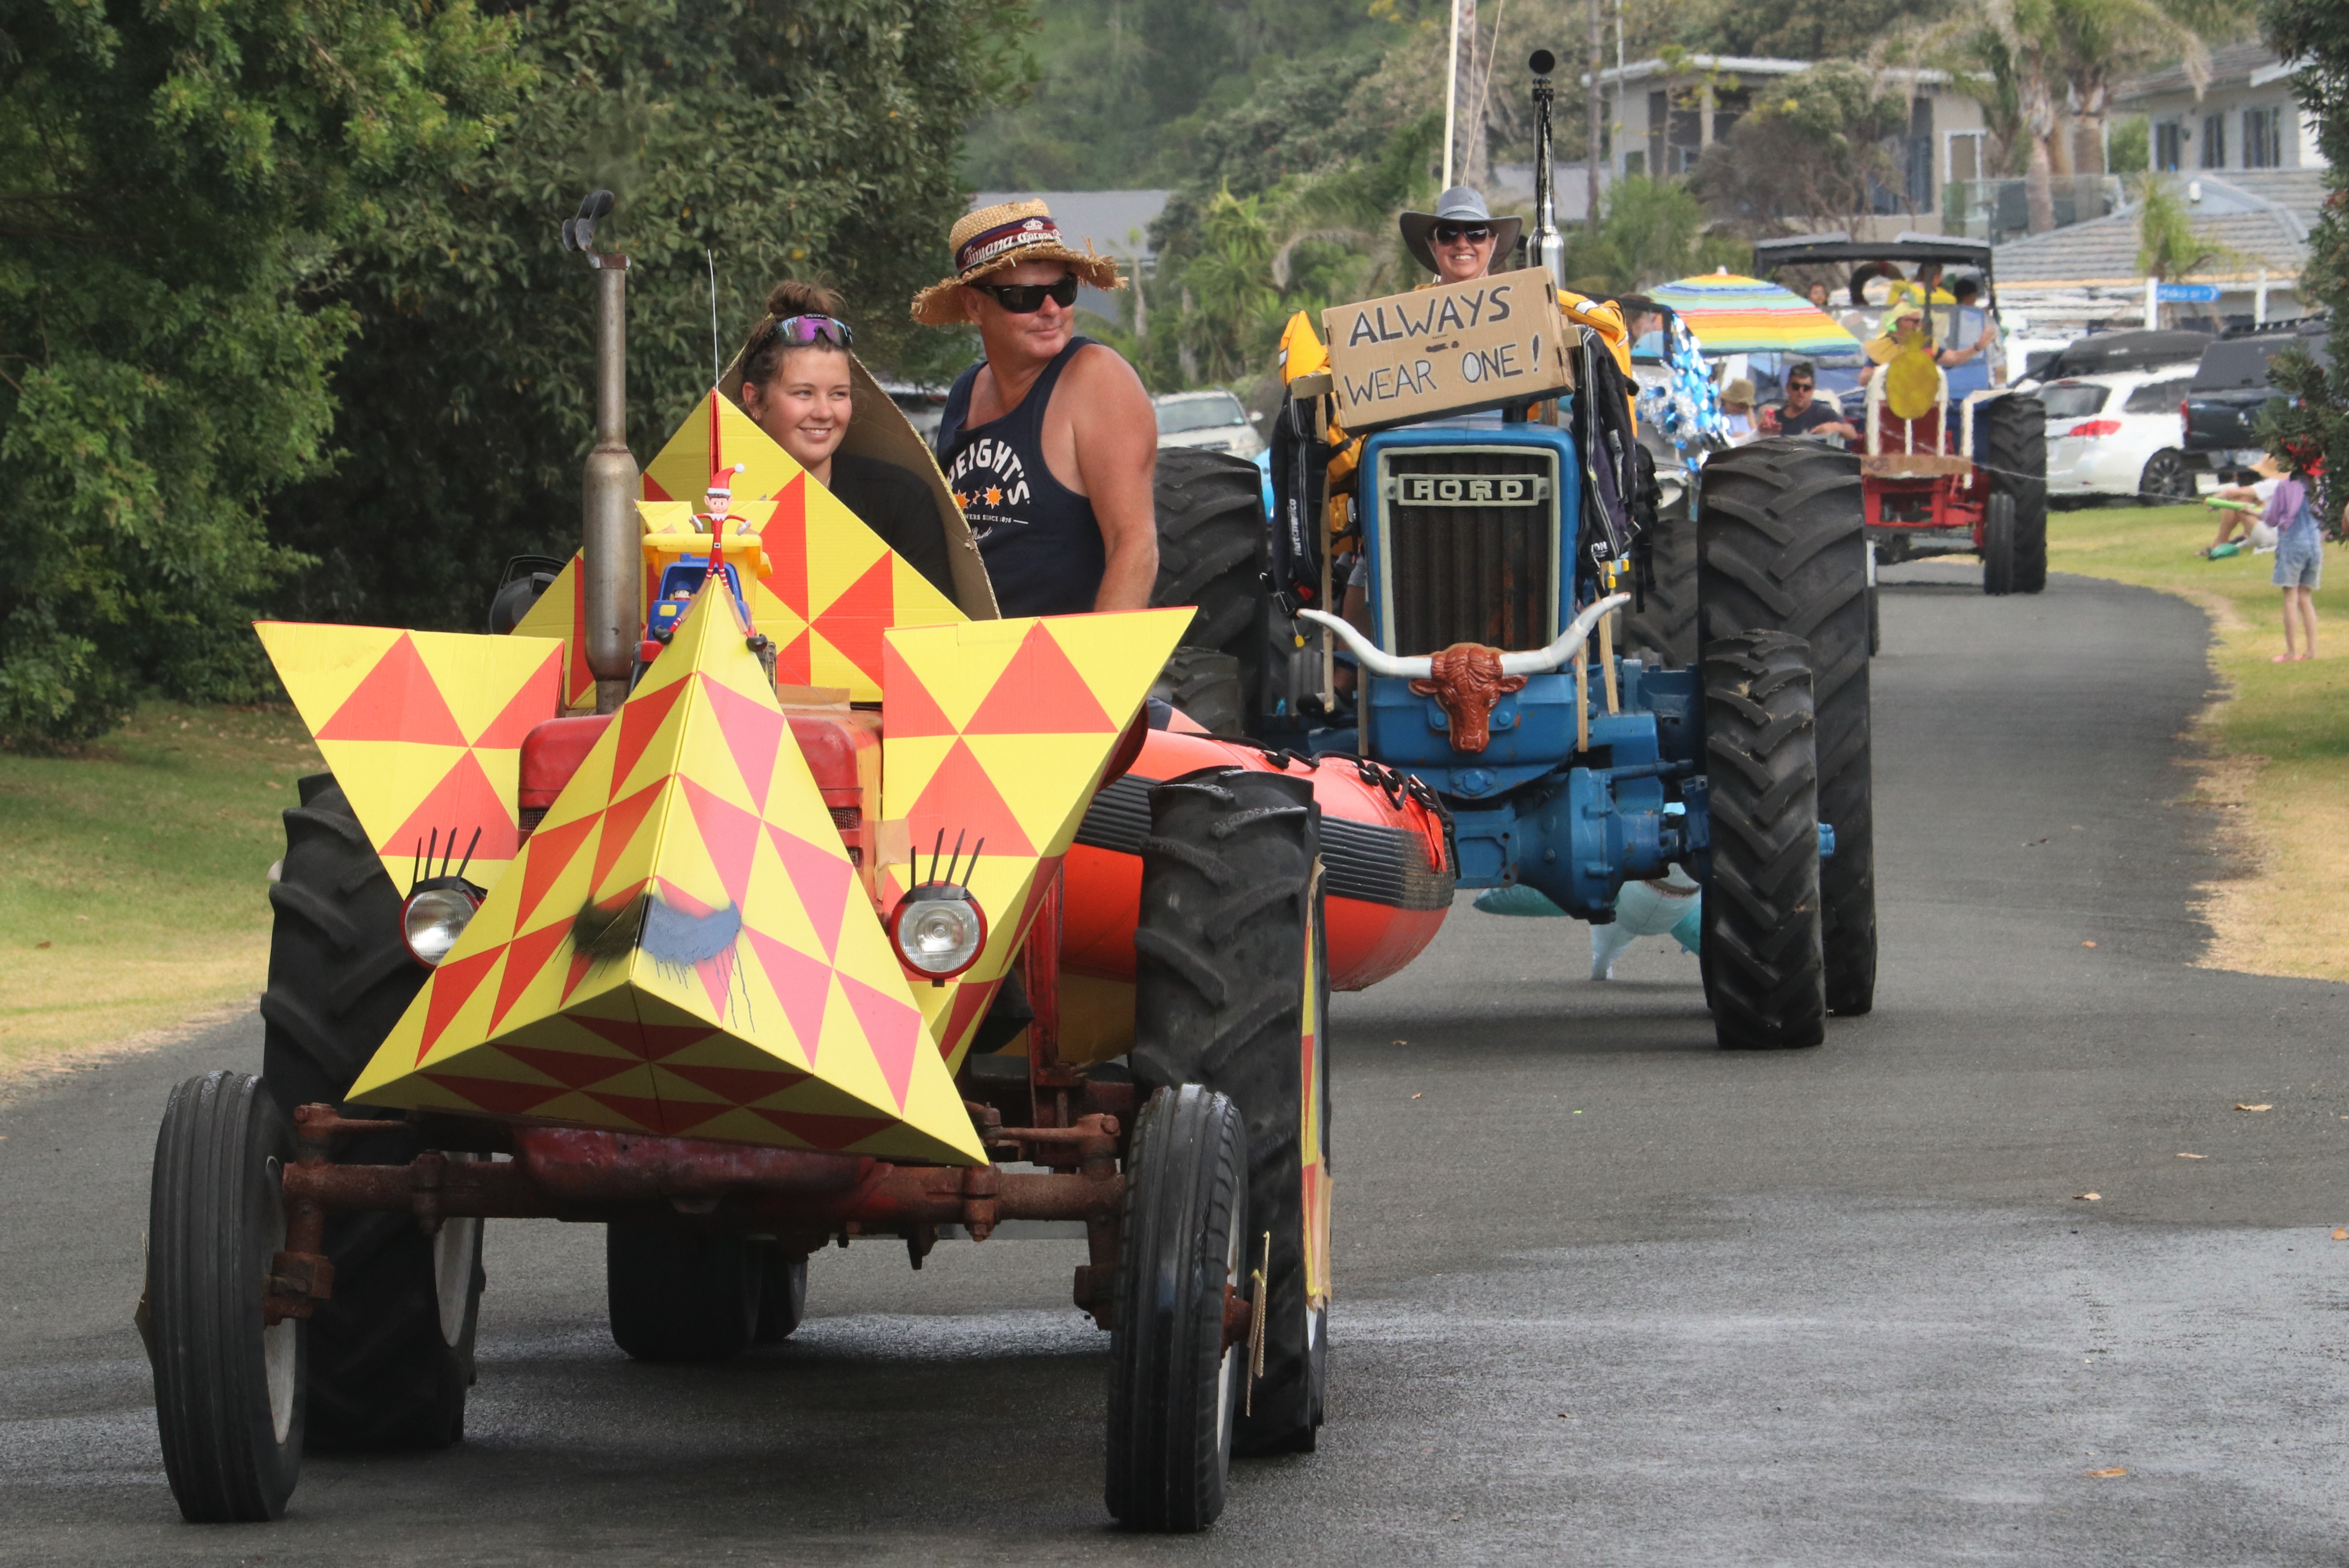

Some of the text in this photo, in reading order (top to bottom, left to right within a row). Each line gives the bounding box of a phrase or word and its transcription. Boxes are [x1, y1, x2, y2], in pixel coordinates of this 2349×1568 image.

[964, 235, 1013, 264] Tijuana
[1017, 231, 1053, 244] Corona
[1349, 286, 1512, 347] ALWAYS
[1344, 360, 1437, 406] WEAR
[947, 438, 1030, 505] PEIGHT'S
[1413, 479, 1523, 499] FORD
